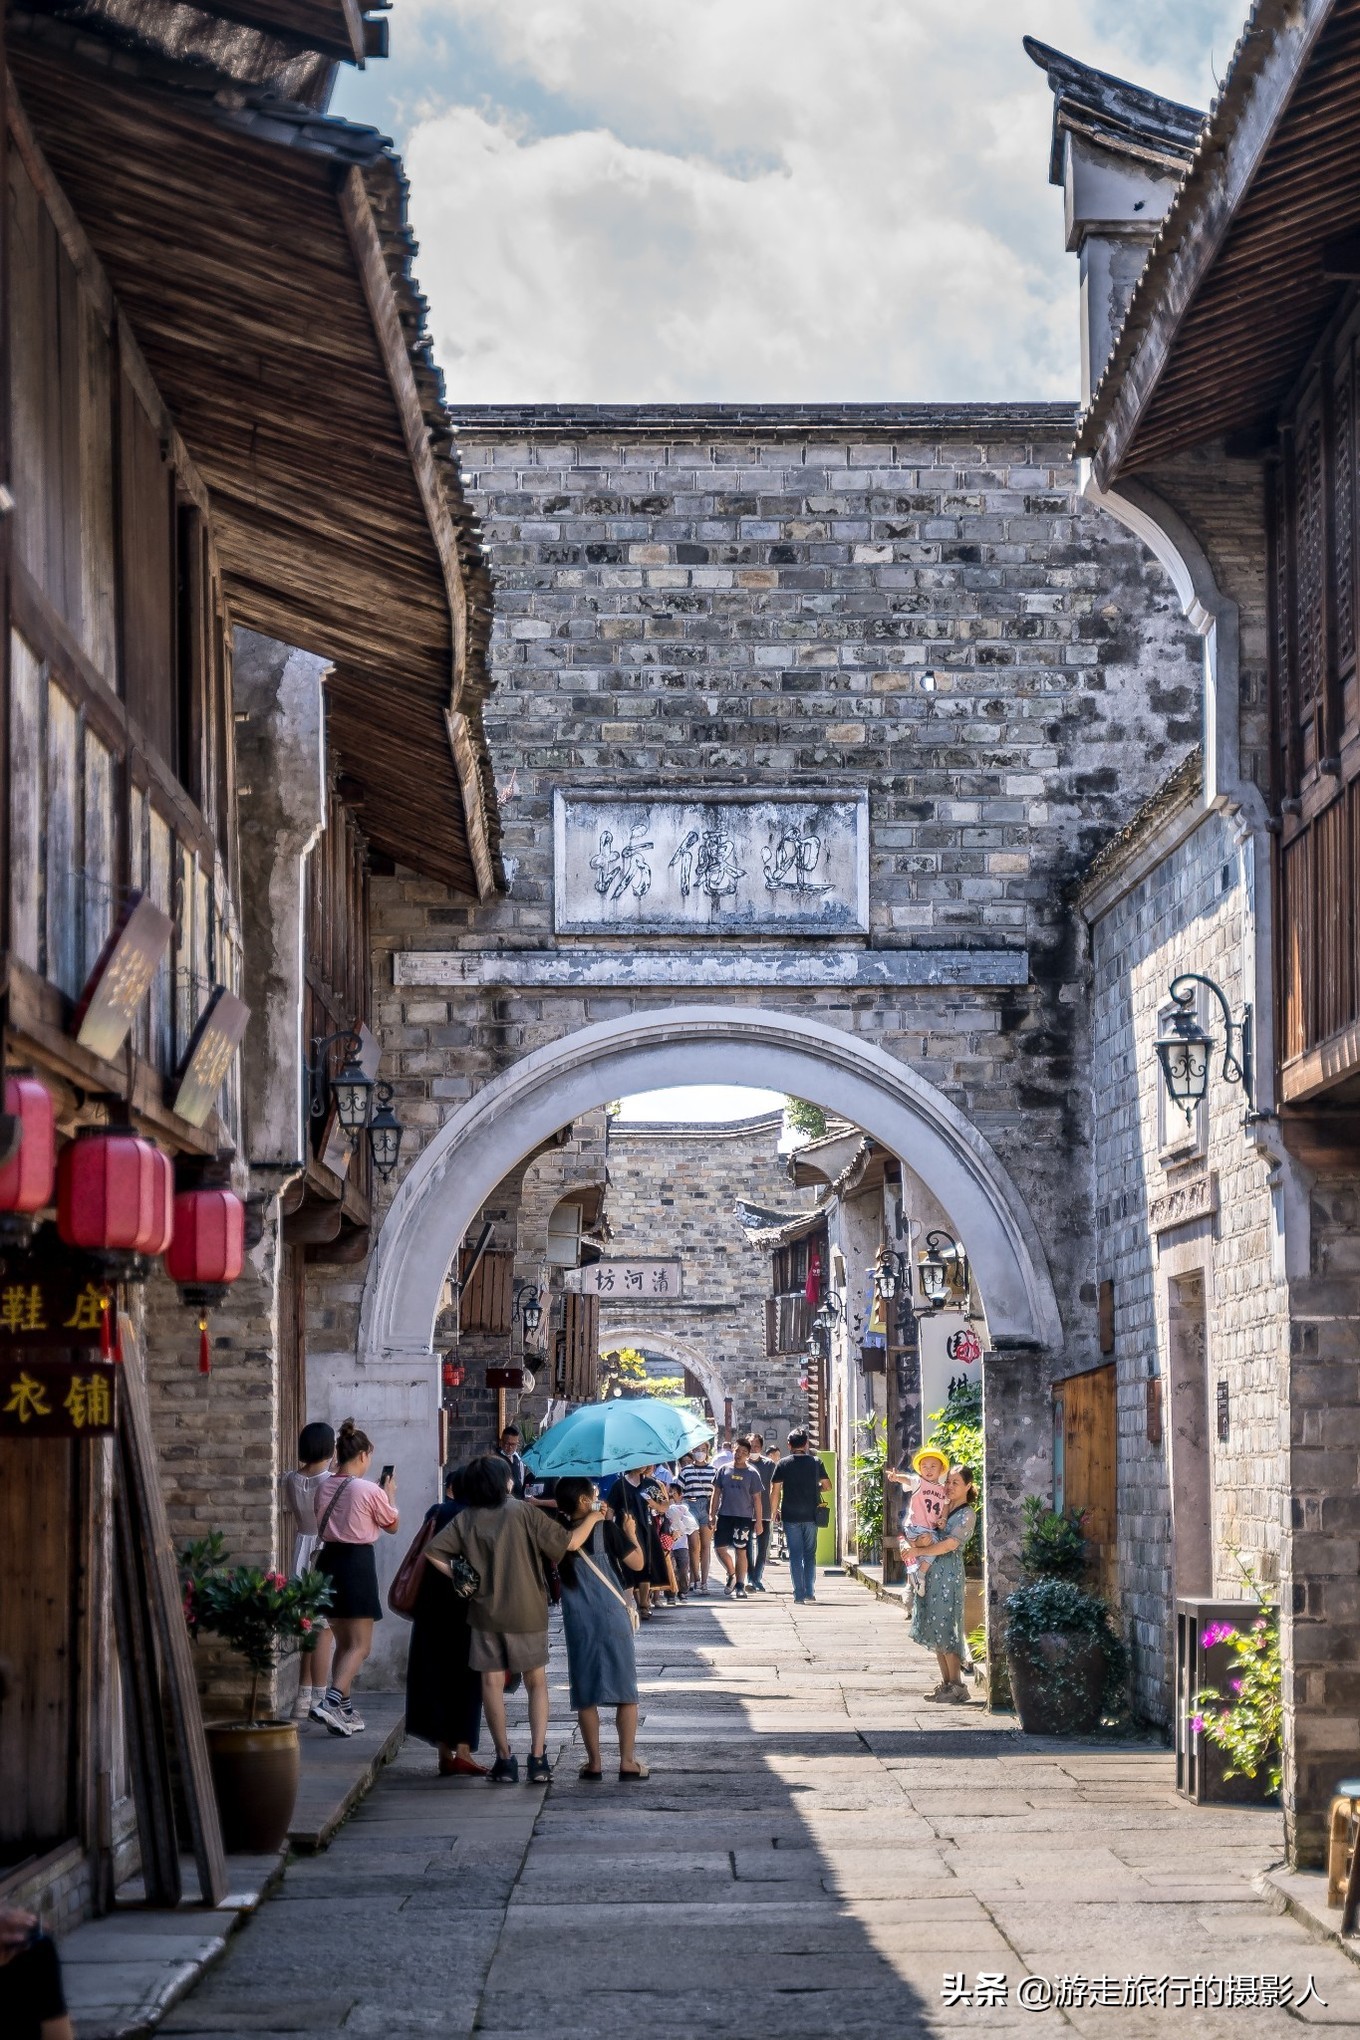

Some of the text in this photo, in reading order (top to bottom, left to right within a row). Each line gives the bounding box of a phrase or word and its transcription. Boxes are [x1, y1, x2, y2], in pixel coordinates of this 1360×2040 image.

[594, 1267, 669, 1292] 清河坊
[0, 1282, 103, 1334] 鞋庄
[3, 1371, 111, 1429] 衣铺
